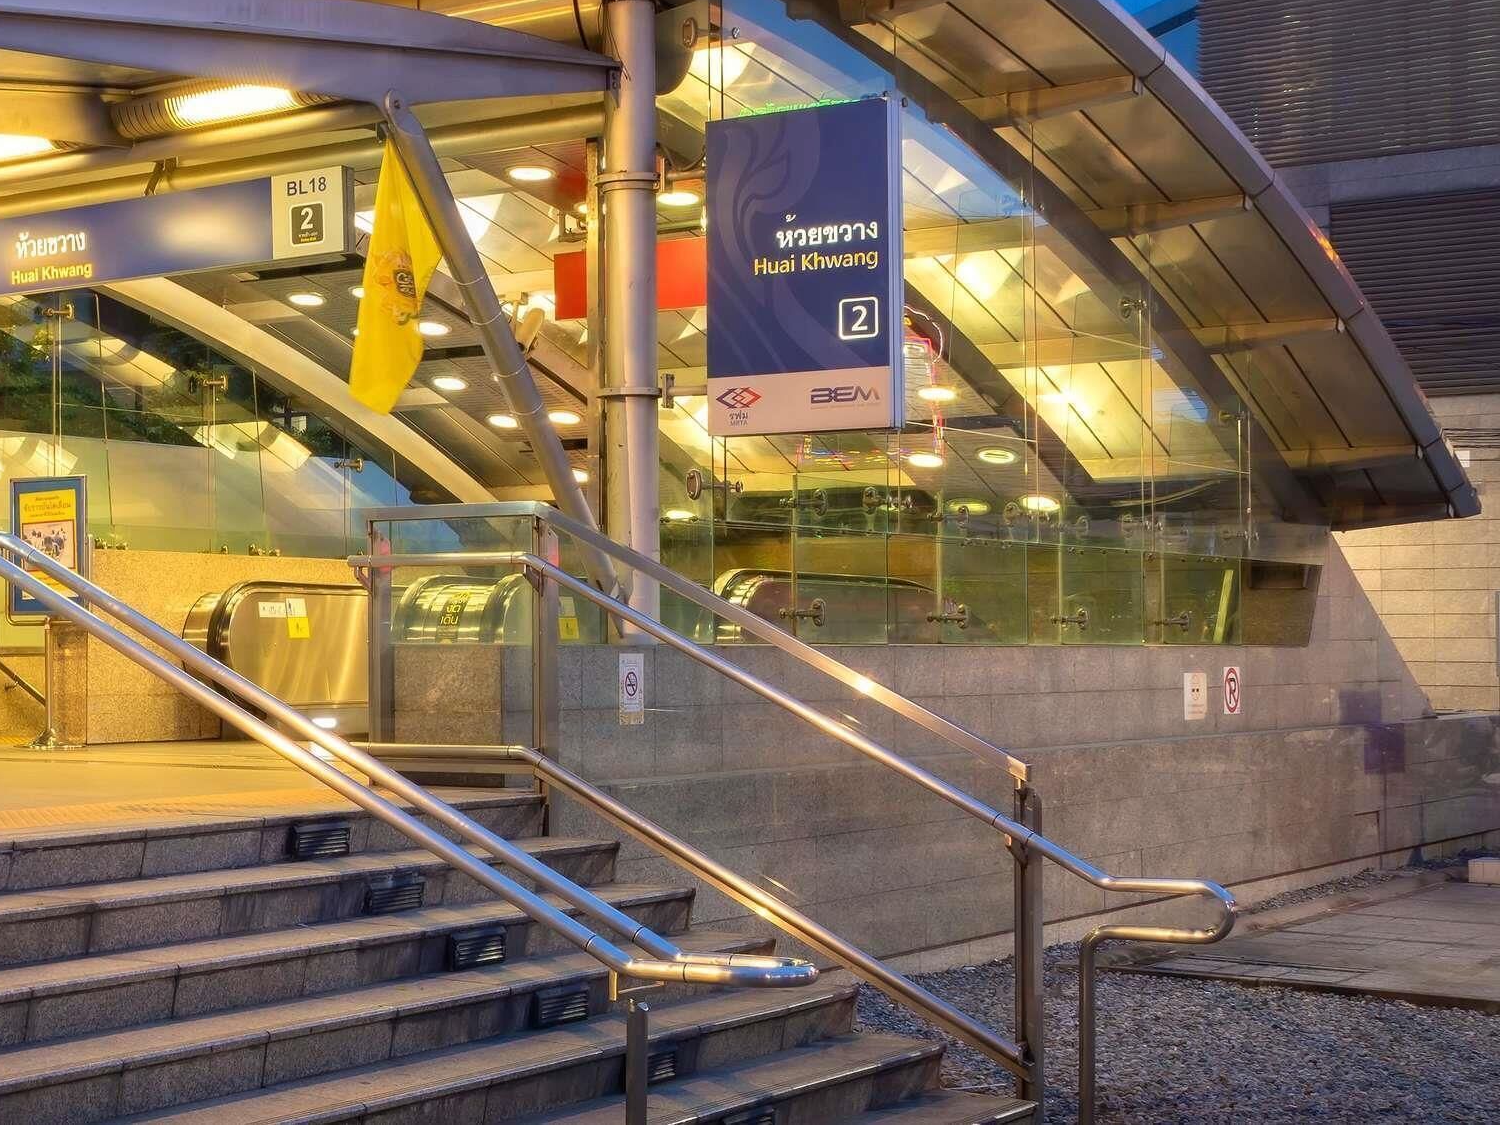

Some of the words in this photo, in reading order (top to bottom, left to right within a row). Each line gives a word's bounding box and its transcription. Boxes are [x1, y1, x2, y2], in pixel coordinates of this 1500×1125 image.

[287, 176, 327, 196] BL18
[300, 207, 314, 230] 2
[776, 213, 879, 248] ห้วยขวาง
[15, 231, 86, 259] ห้วยขวาง
[11, 267, 39, 285] Huai
[41, 263, 93, 281] Khwang
[754, 254, 796, 276] Huai
[801, 249, 879, 272] Khwang
[851, 304, 869, 332] 2
[810, 385, 880, 404] BEM
